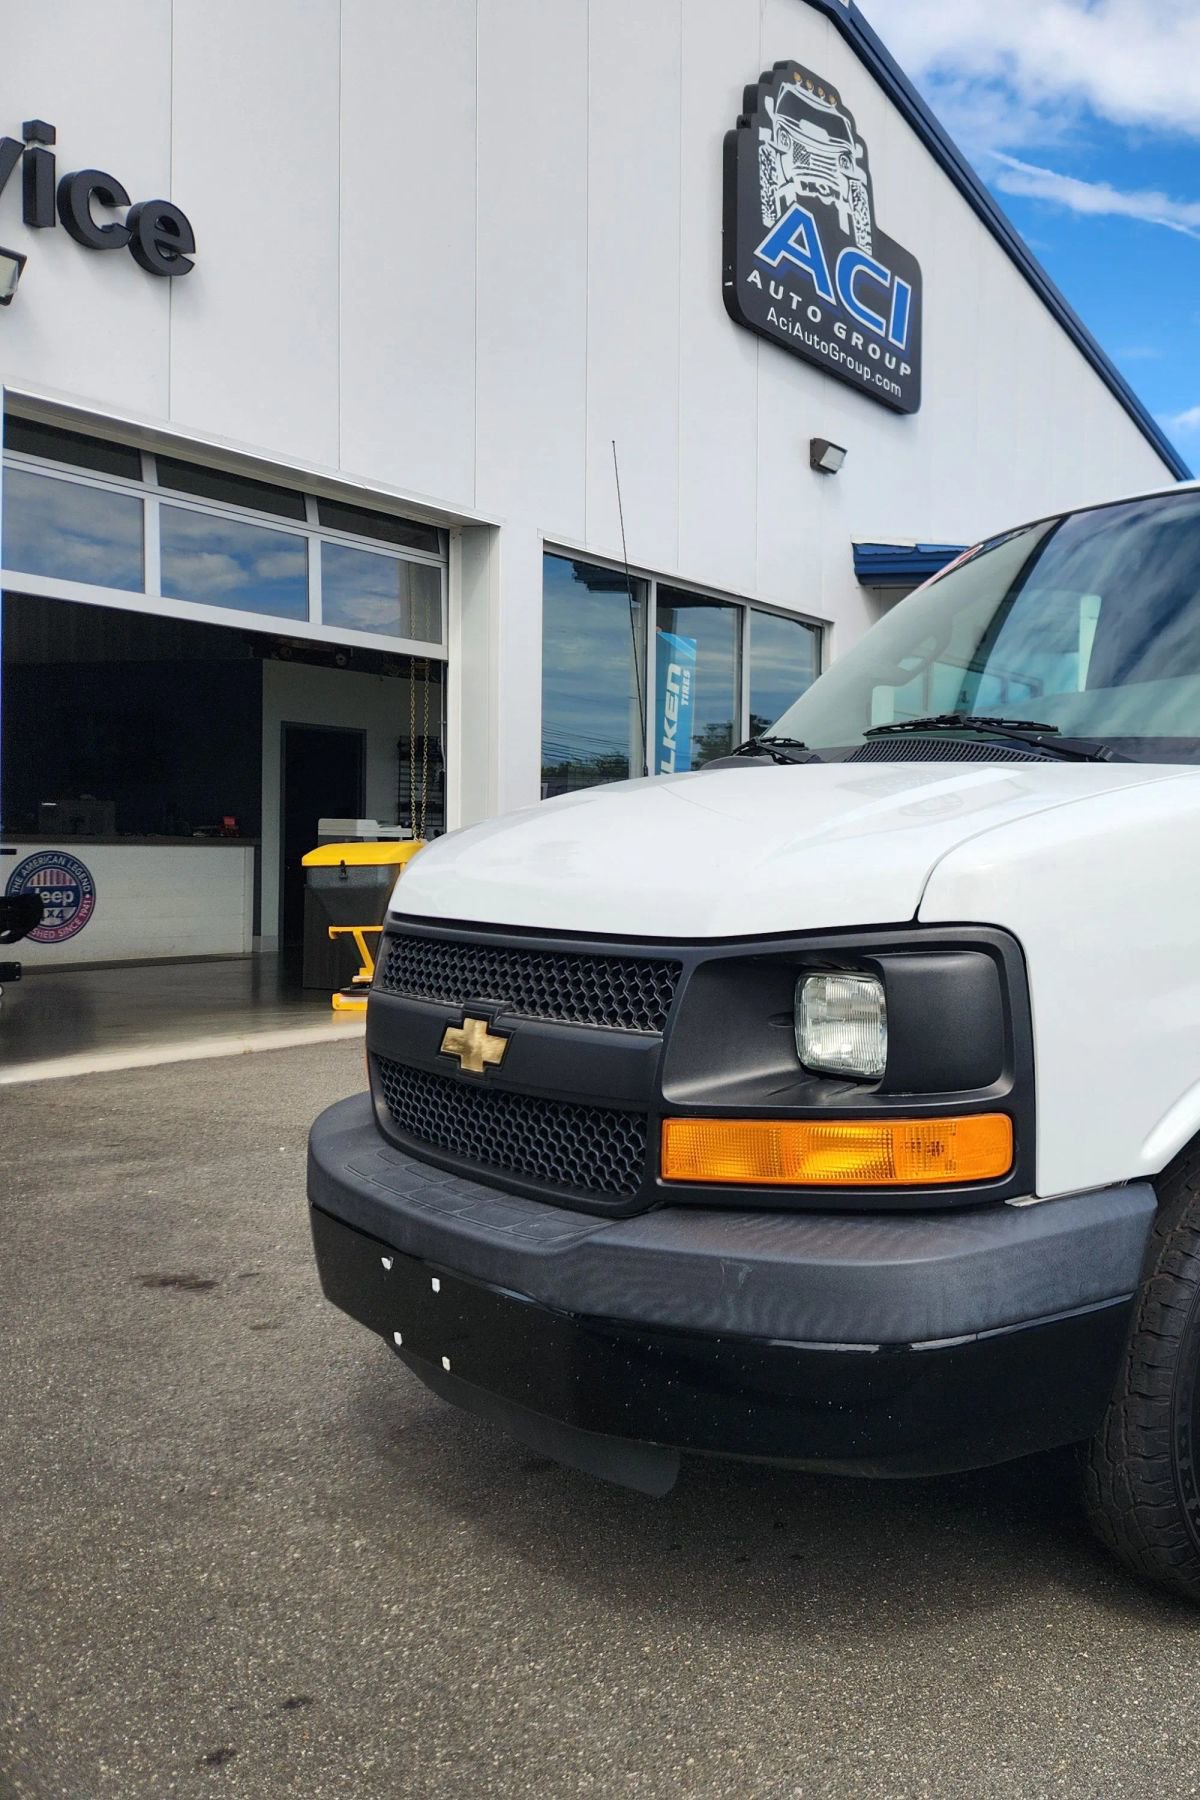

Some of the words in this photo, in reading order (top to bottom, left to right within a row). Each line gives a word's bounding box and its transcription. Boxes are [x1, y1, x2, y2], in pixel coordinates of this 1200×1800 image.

[754, 202, 912, 350] ACI
[746, 269, 822, 324] AUTO
[833, 321, 912, 376] GROUP
[766, 306, 902, 398] AciAutoGroup.com
[681, 669, 691, 706] TIRES
[12, 877, 23, 893] THE
[22, 855, 65, 877] AMERICAN
[67, 860, 91, 892] LEGEND
[35, 887, 75, 907] eep
[57, 918, 82, 937] SINCE
